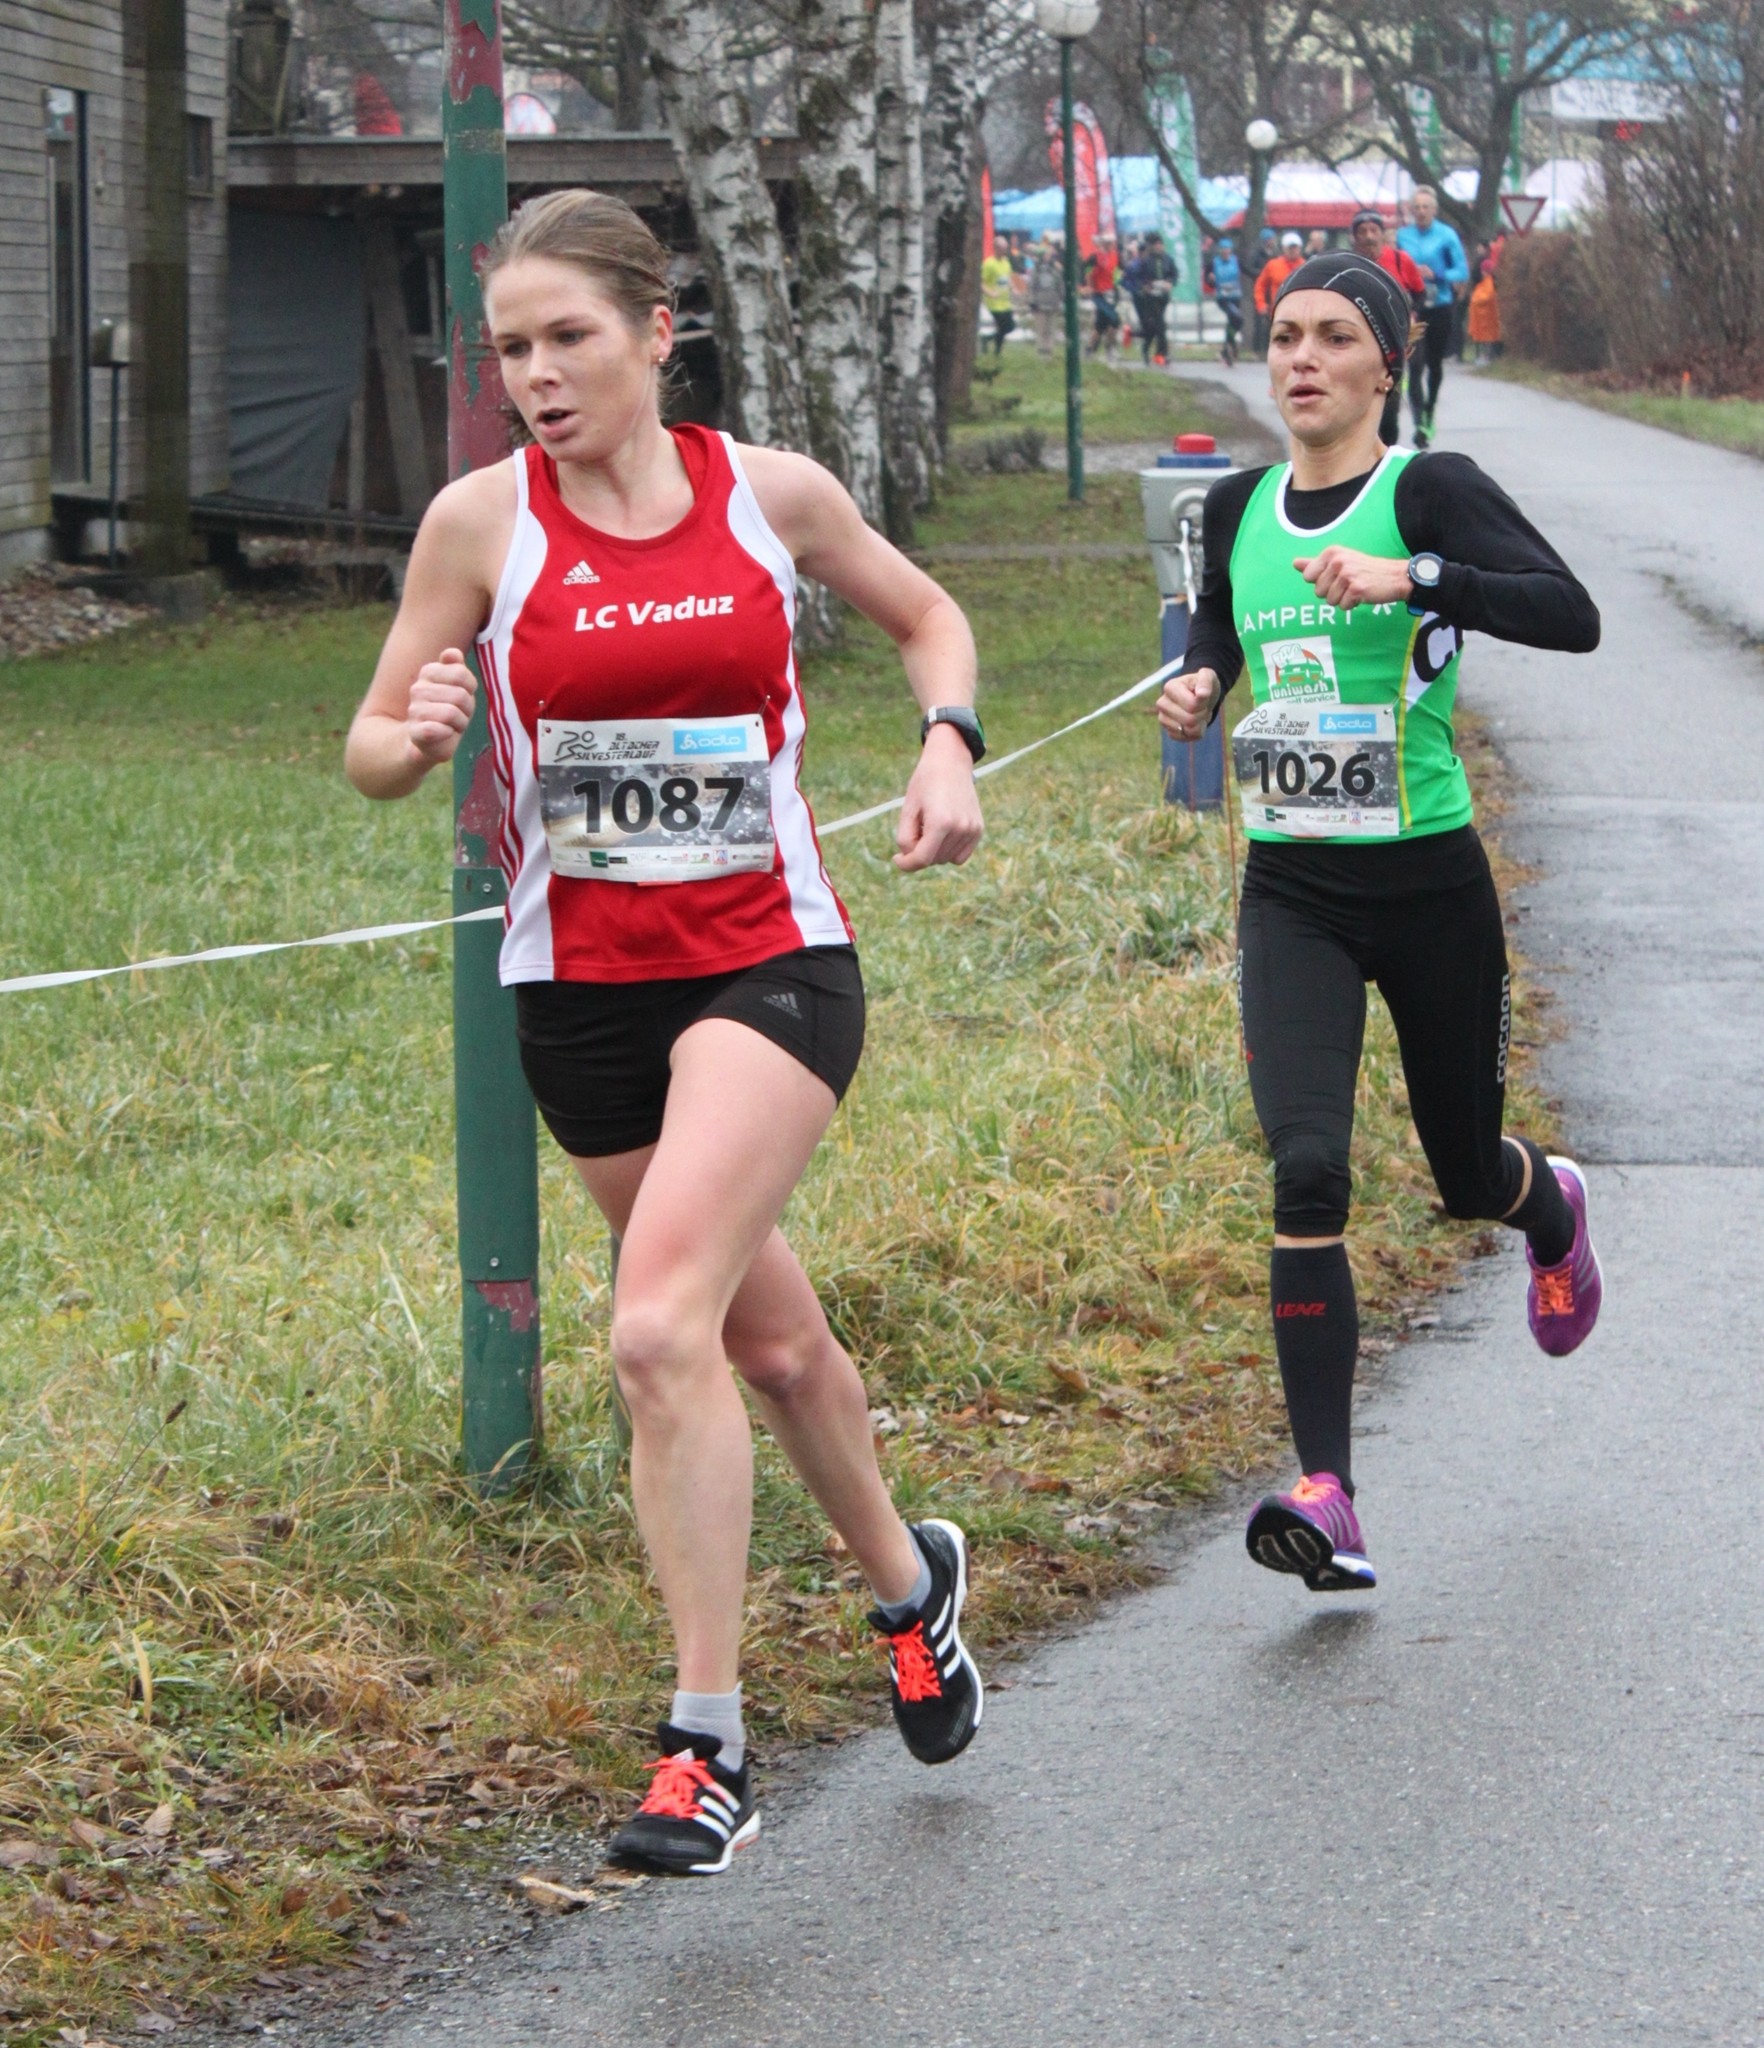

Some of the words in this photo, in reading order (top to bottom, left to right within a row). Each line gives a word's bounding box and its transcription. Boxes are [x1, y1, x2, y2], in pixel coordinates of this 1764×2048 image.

[563, 575, 600, 585] adidas
[575, 605, 618, 632] LC
[627, 595, 734, 626] Vaduz
[1273, 680, 1328, 698] uniwash
[1304, 694, 1337, 704] service
[1253, 726, 1308, 736] SILVESTERLAUF
[1337, 719, 1373, 729] odlo
[697, 734, 742, 747] odlo
[575, 750, 656, 761] SILVESTERLAUF
[1252, 750, 1376, 798] 1026
[572, 776, 745, 835] 1087
[1497, 973, 1511, 1083] cocoon
[1275, 1302, 1327, 1318] LENZ
